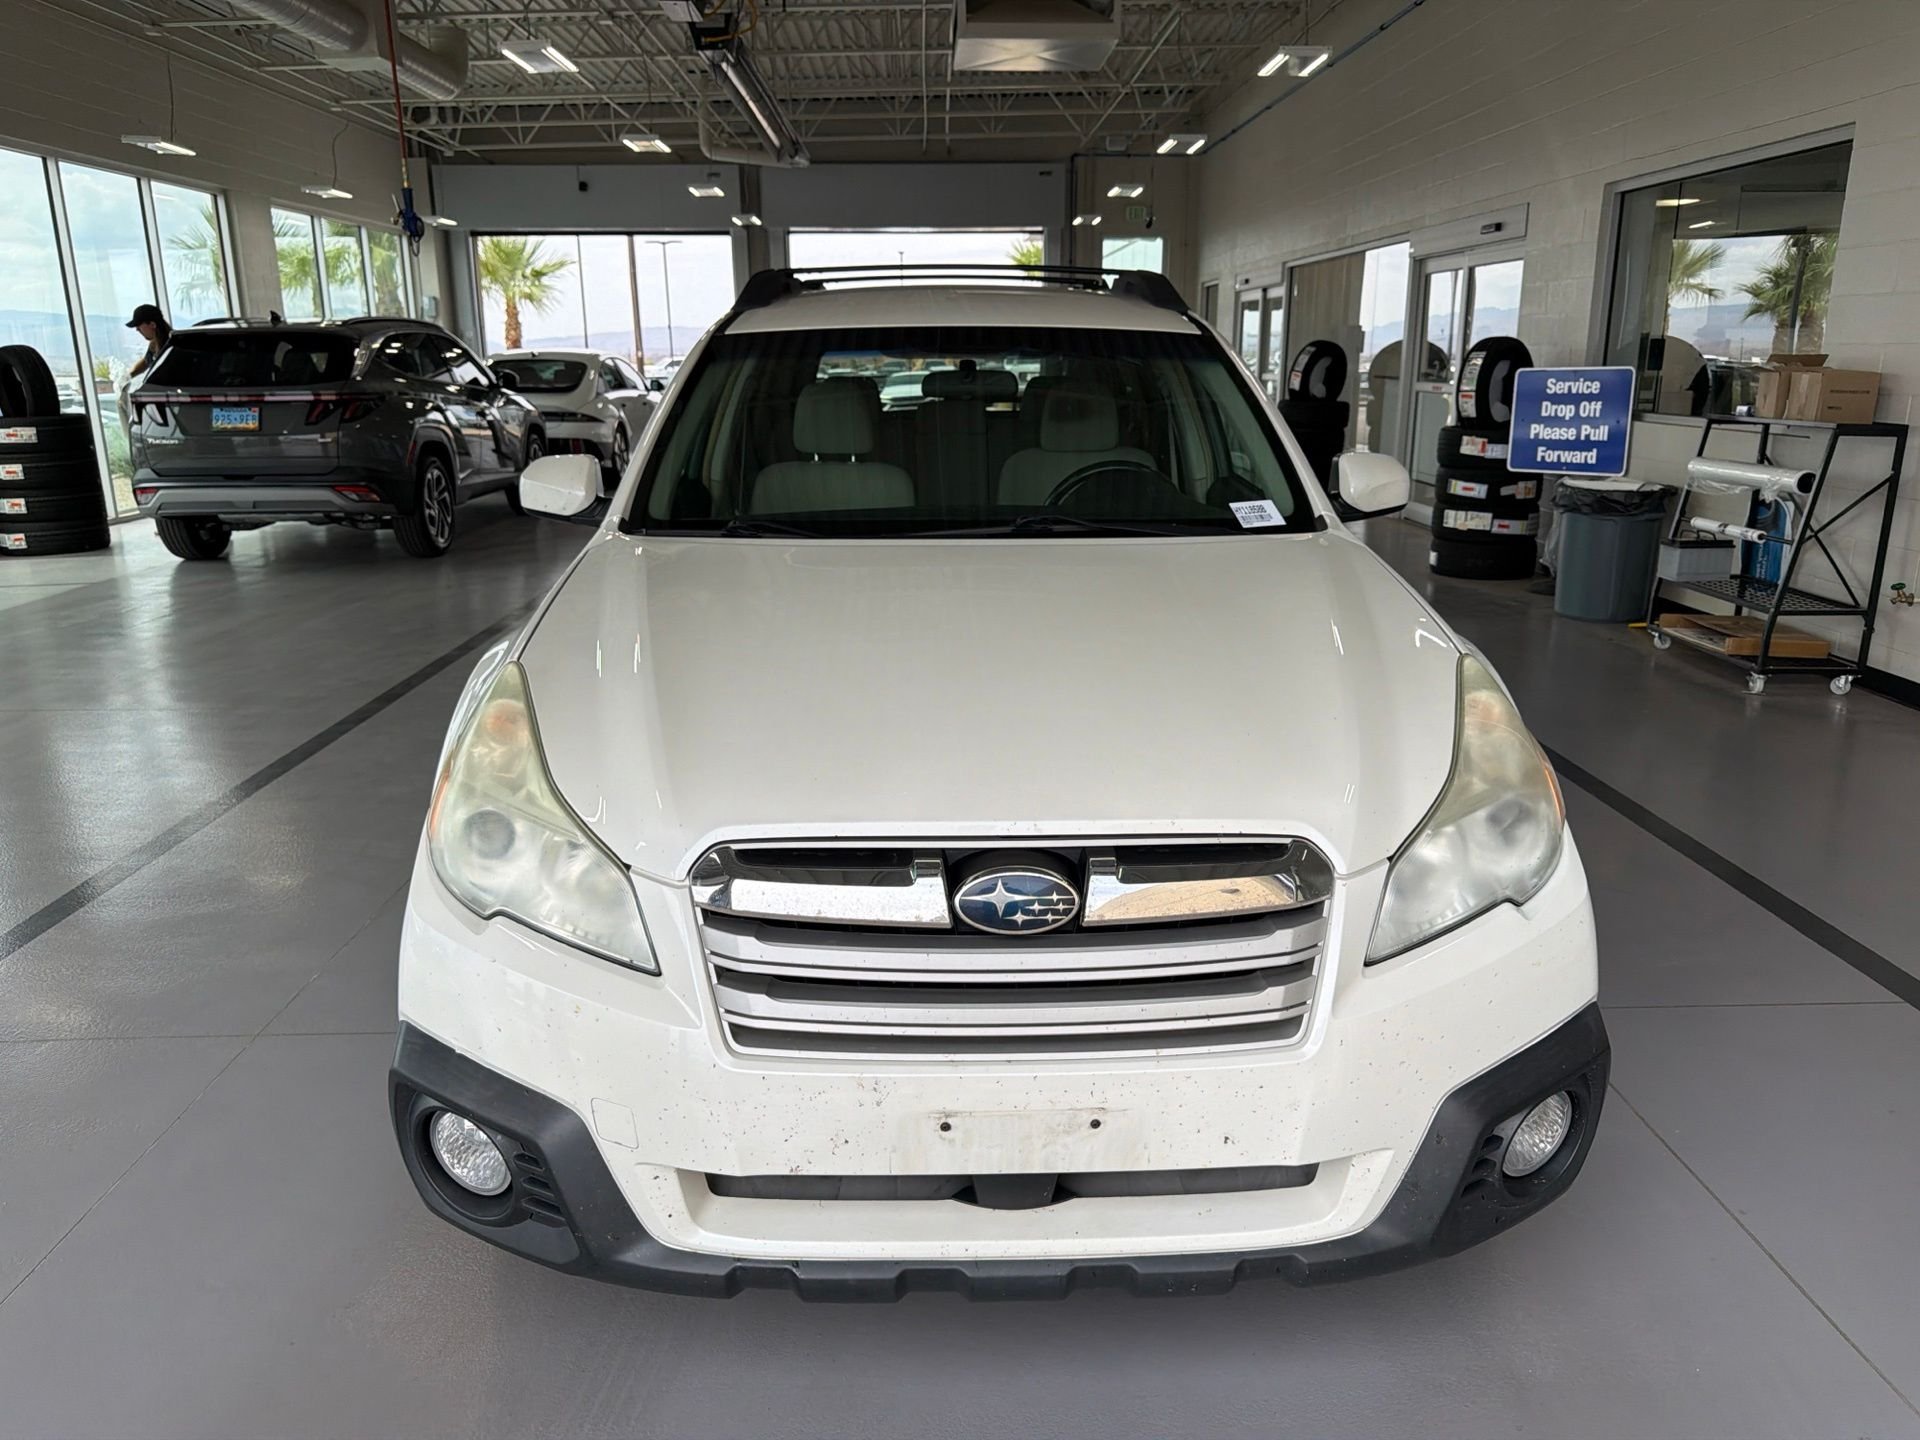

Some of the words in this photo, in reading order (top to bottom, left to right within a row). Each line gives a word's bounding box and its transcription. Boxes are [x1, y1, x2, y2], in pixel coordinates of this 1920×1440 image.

[1546, 378, 1600, 394] Service
[1541, 401, 1575, 420] Drop
[1579, 401, 1602, 417] Off
[1529, 424, 1577, 440] Please
[1580, 425, 1609, 441] Pull
[1536, 446, 1598, 464] Forward
